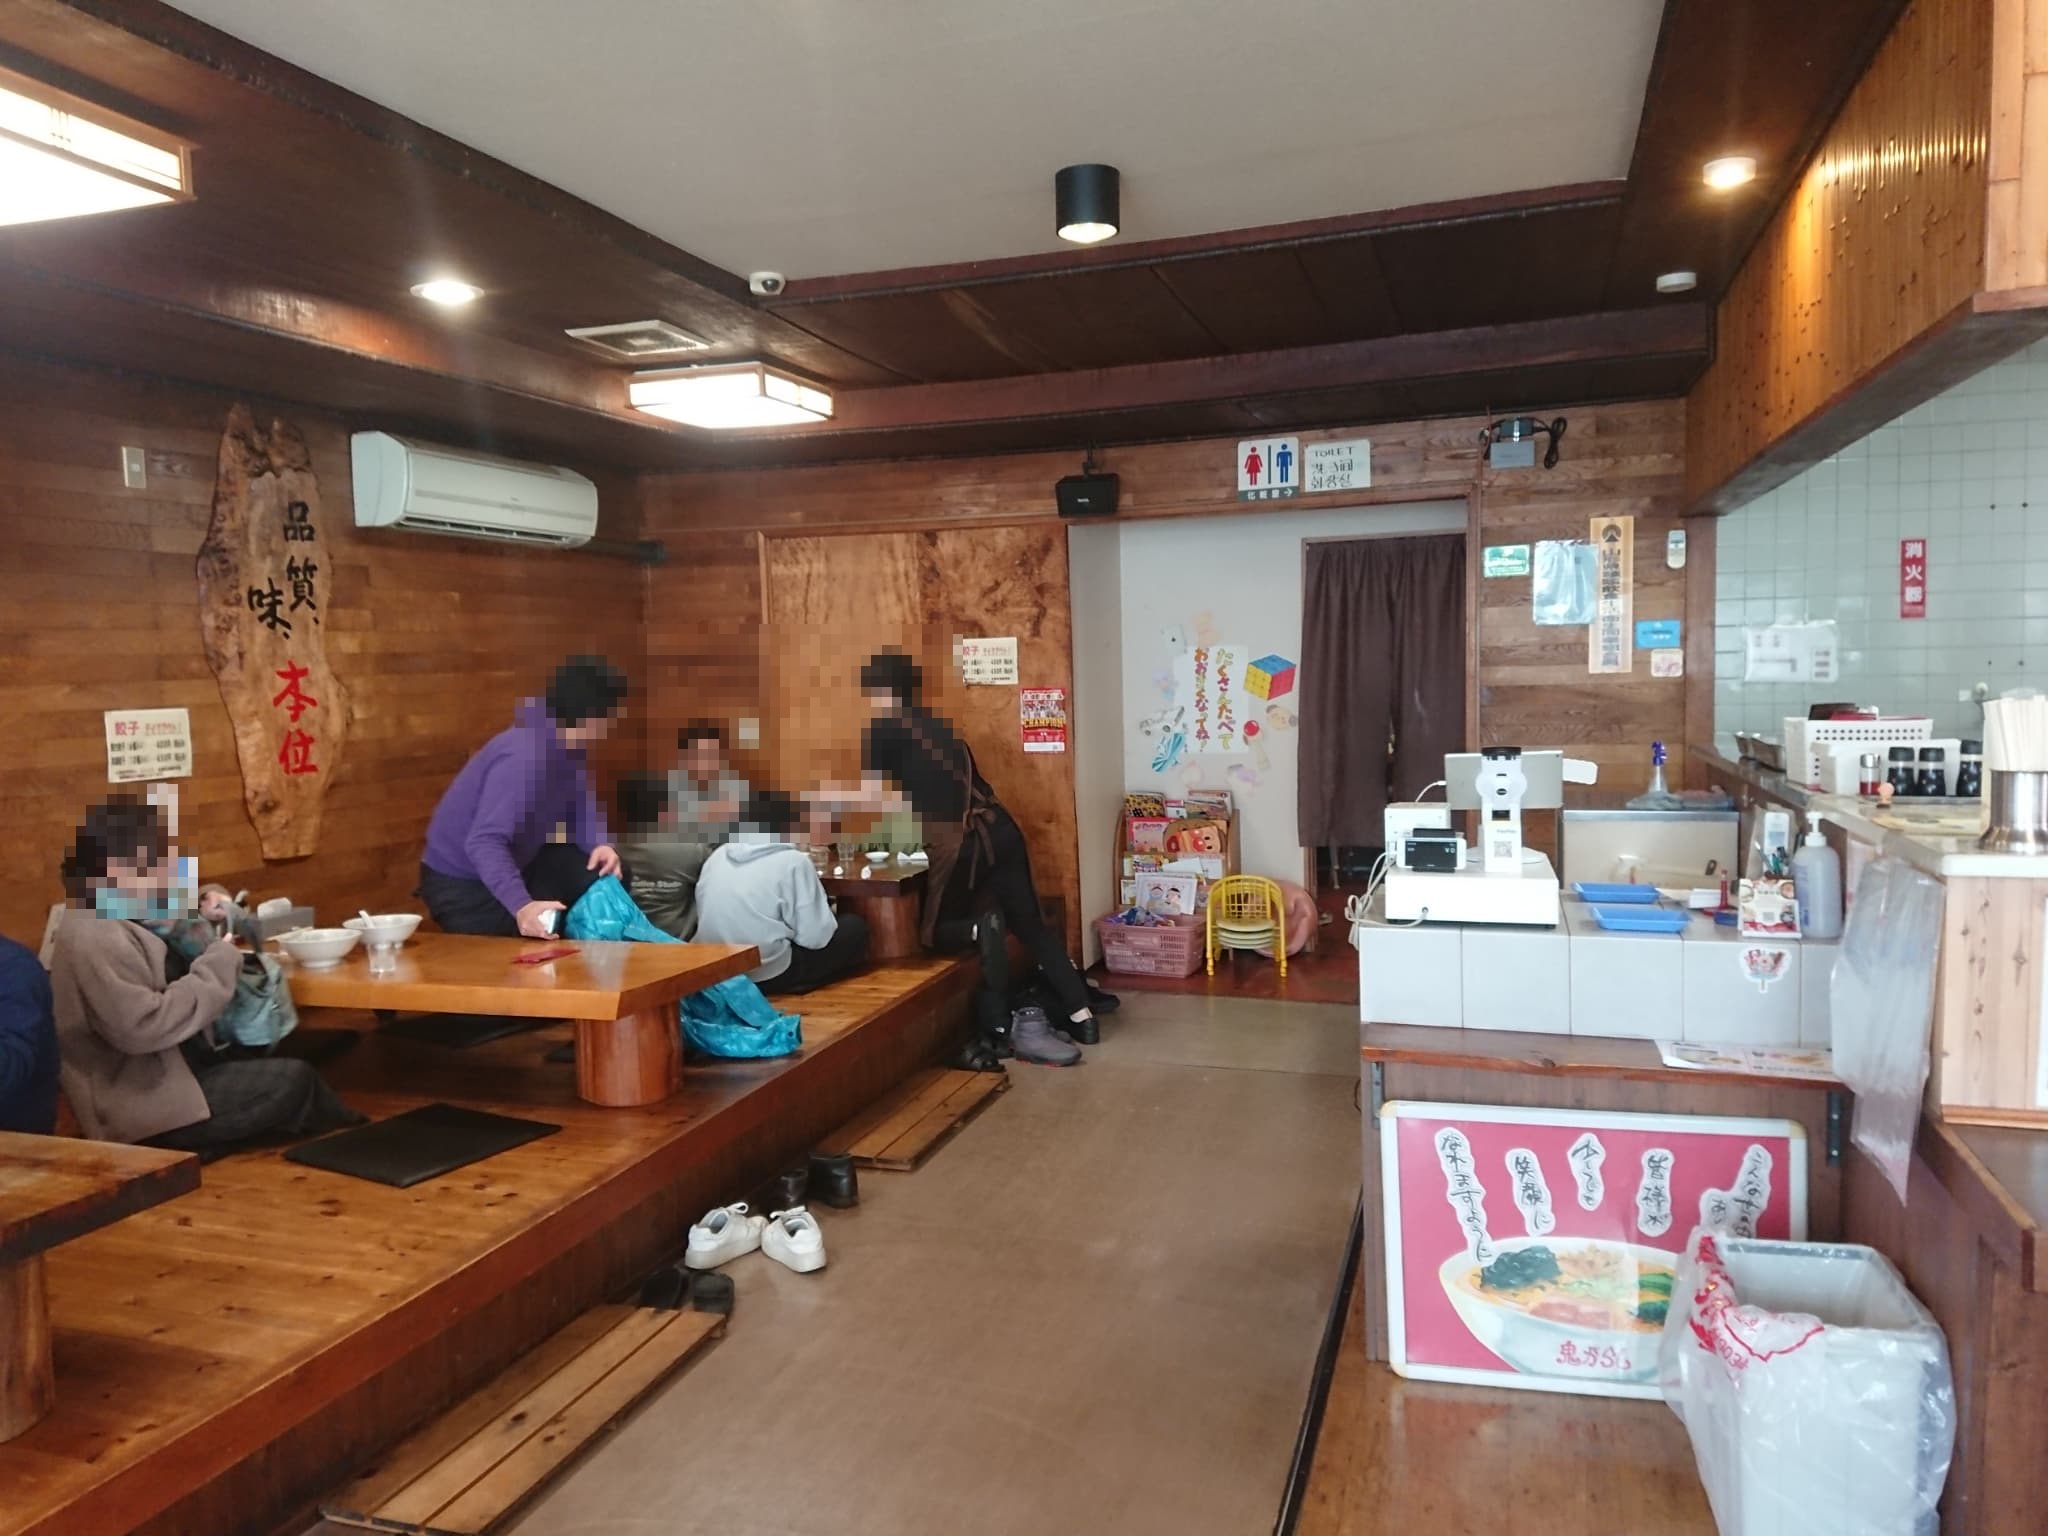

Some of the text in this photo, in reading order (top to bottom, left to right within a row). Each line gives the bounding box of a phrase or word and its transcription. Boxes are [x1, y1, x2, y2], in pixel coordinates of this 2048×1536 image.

[1904, 542, 1923, 603] 消火器
[115, 721, 139, 736] 餃子
[273, 660, 319, 776] 本位
[1023, 718, 1064, 728] CHAMPION
[1440, 1135, 1493, 1263] なれますように
[1514, 1155, 1551, 1230] 笑顔に
[1642, 1154, 1669, 1226] 皆様が
